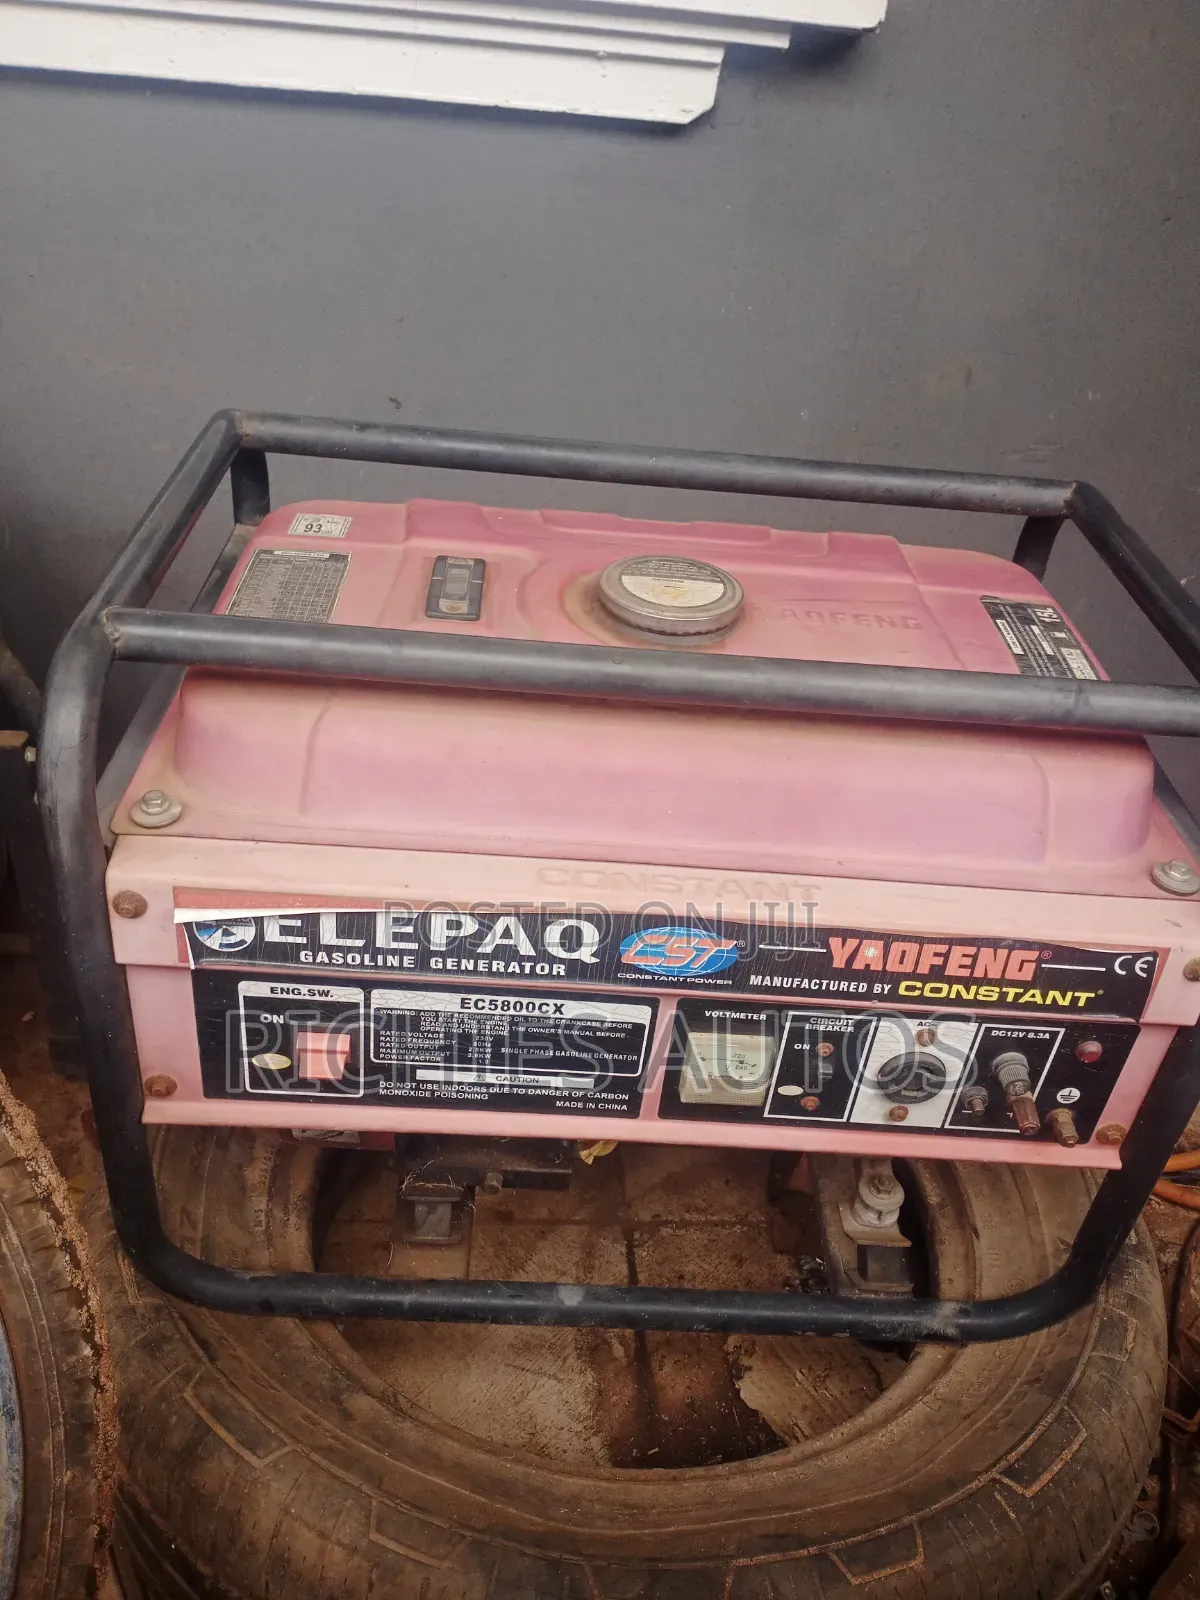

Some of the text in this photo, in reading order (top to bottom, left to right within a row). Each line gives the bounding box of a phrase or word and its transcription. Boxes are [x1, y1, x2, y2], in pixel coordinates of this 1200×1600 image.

[304, 523, 322, 533] 93
[536, 867, 821, 901] CONSTANT
[263, 911, 600, 964] ELEPAQ
[300, 950, 567, 976] GASOLINE GENERATOR
[828, 936, 1040, 981] YAOFENG
[617, 972, 733, 985] CONSTANT POWER
[270, 986, 334, 998] ENG.SW.
[749, 974, 1096, 1007] MANUFACTURED BY CONSTANT
[460, 997, 566, 1016] EC5800CX
[259, 1013, 284, 1024] ON
[454, 1013, 512, 1021] RECOMMENDED
[555, 1019, 601, 1027] CRANKCASE
[704, 1010, 767, 1021] VOLTMETER
[460, 1023, 510, 1031] UNDERSTAND
[810, 1017, 854, 1026] CIRCUIT
[805, 1023, 854, 1032] BREAKER
[991, 1030, 1050, 1040] DC12V 8.3A
[407, 1037, 457, 1045] FREQUENCY
[501, 1047, 530, 1055] SINGLE
[555, 1050, 592, 1059] GASOLINE
[594, 1053, 638, 1061] GENERATOR
[496, 1075, 540, 1084] CAUTION
[379, 1089, 489, 1100] MONOXIDE POISONING
[442, 1084, 487, 1092] INDOORS
[528, 1088, 569, 1097] DANGER
[587, 1091, 629, 1100] CARBON
[555, 1100, 584, 1108] MADE
